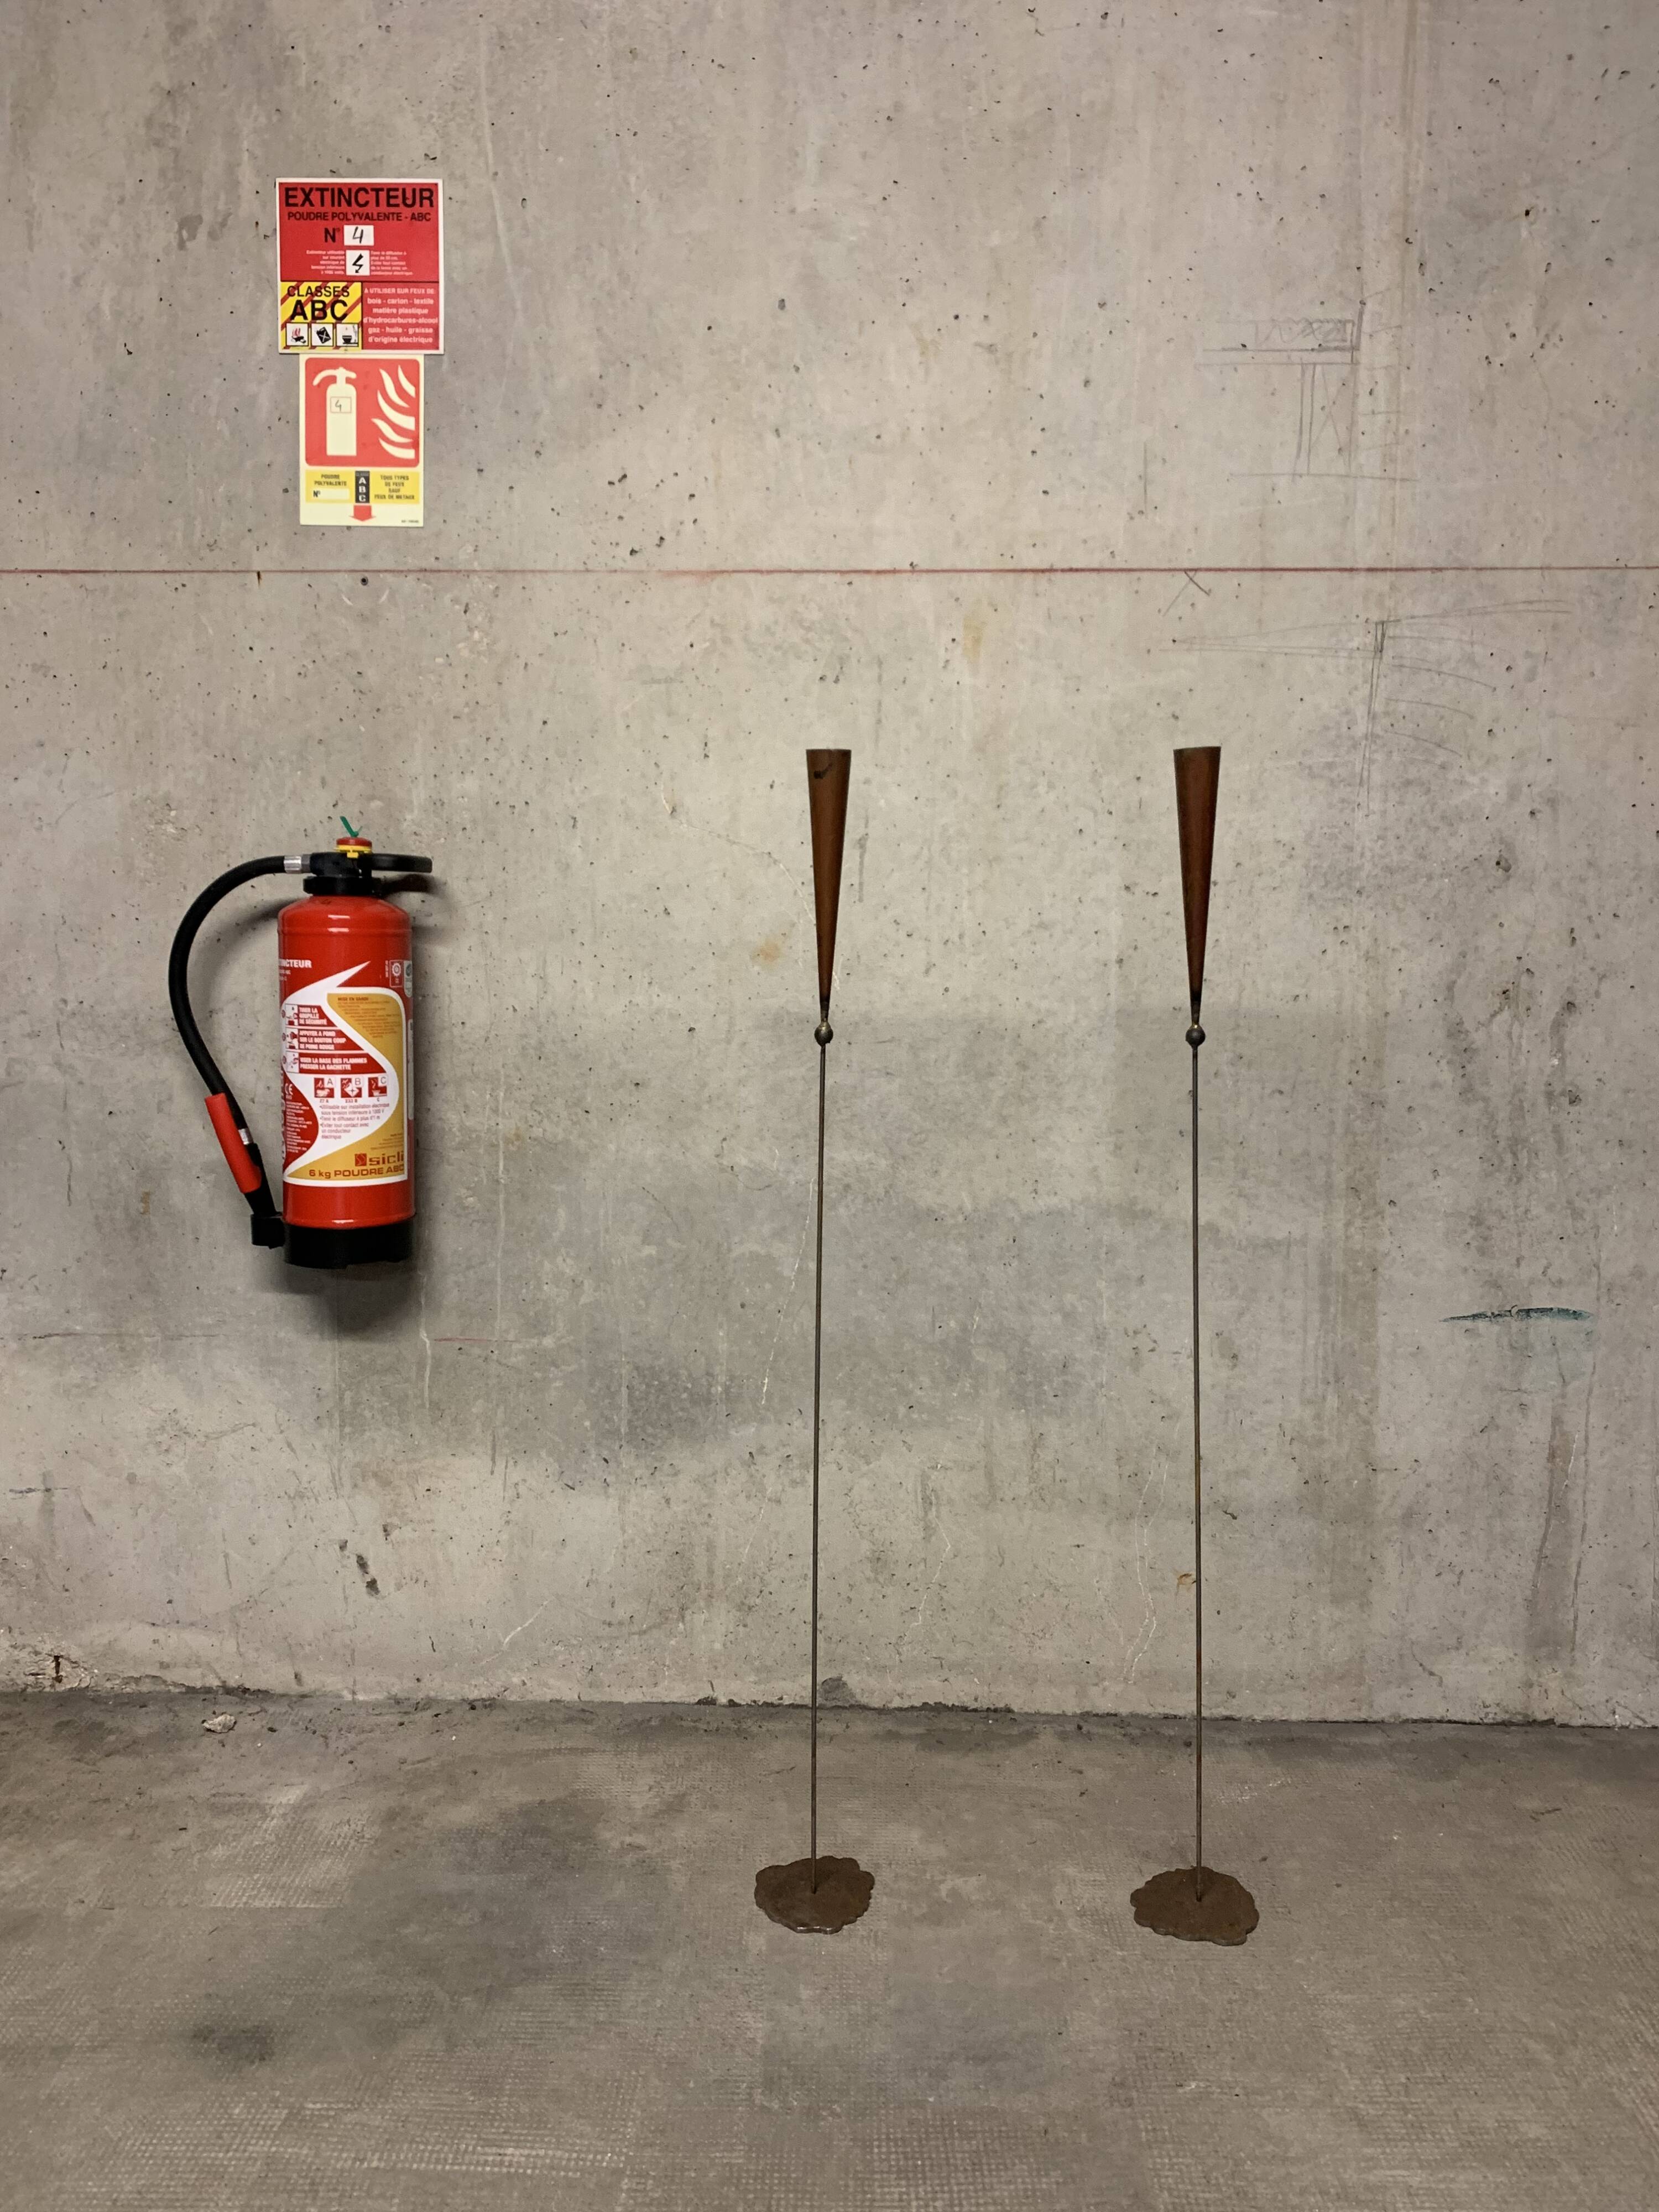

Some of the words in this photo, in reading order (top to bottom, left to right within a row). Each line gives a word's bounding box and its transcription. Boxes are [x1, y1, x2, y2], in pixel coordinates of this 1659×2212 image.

[285, 187, 434, 208] EXTINCTEUR
[288, 211, 328, 221] POUDRE
[332, 211, 402, 221] POLYVALENTE
[410, 212, 431, 222] ABC
[352, 226, 364, 244] 4
[288, 285, 350, 298] CLASSES
[290, 299, 348, 321] ABC
[399, 336, 434, 344] électrique
[335, 399, 342, 412] 4
[354, 1077, 361, 1086] B
[380, 1076, 387, 1084] C
[369, 1150, 404, 1166] sicli
[318, 1169, 331, 1179] kg
[333, 1167, 384, 1177] POUDRE
[386, 1163, 404, 1173] ABC
